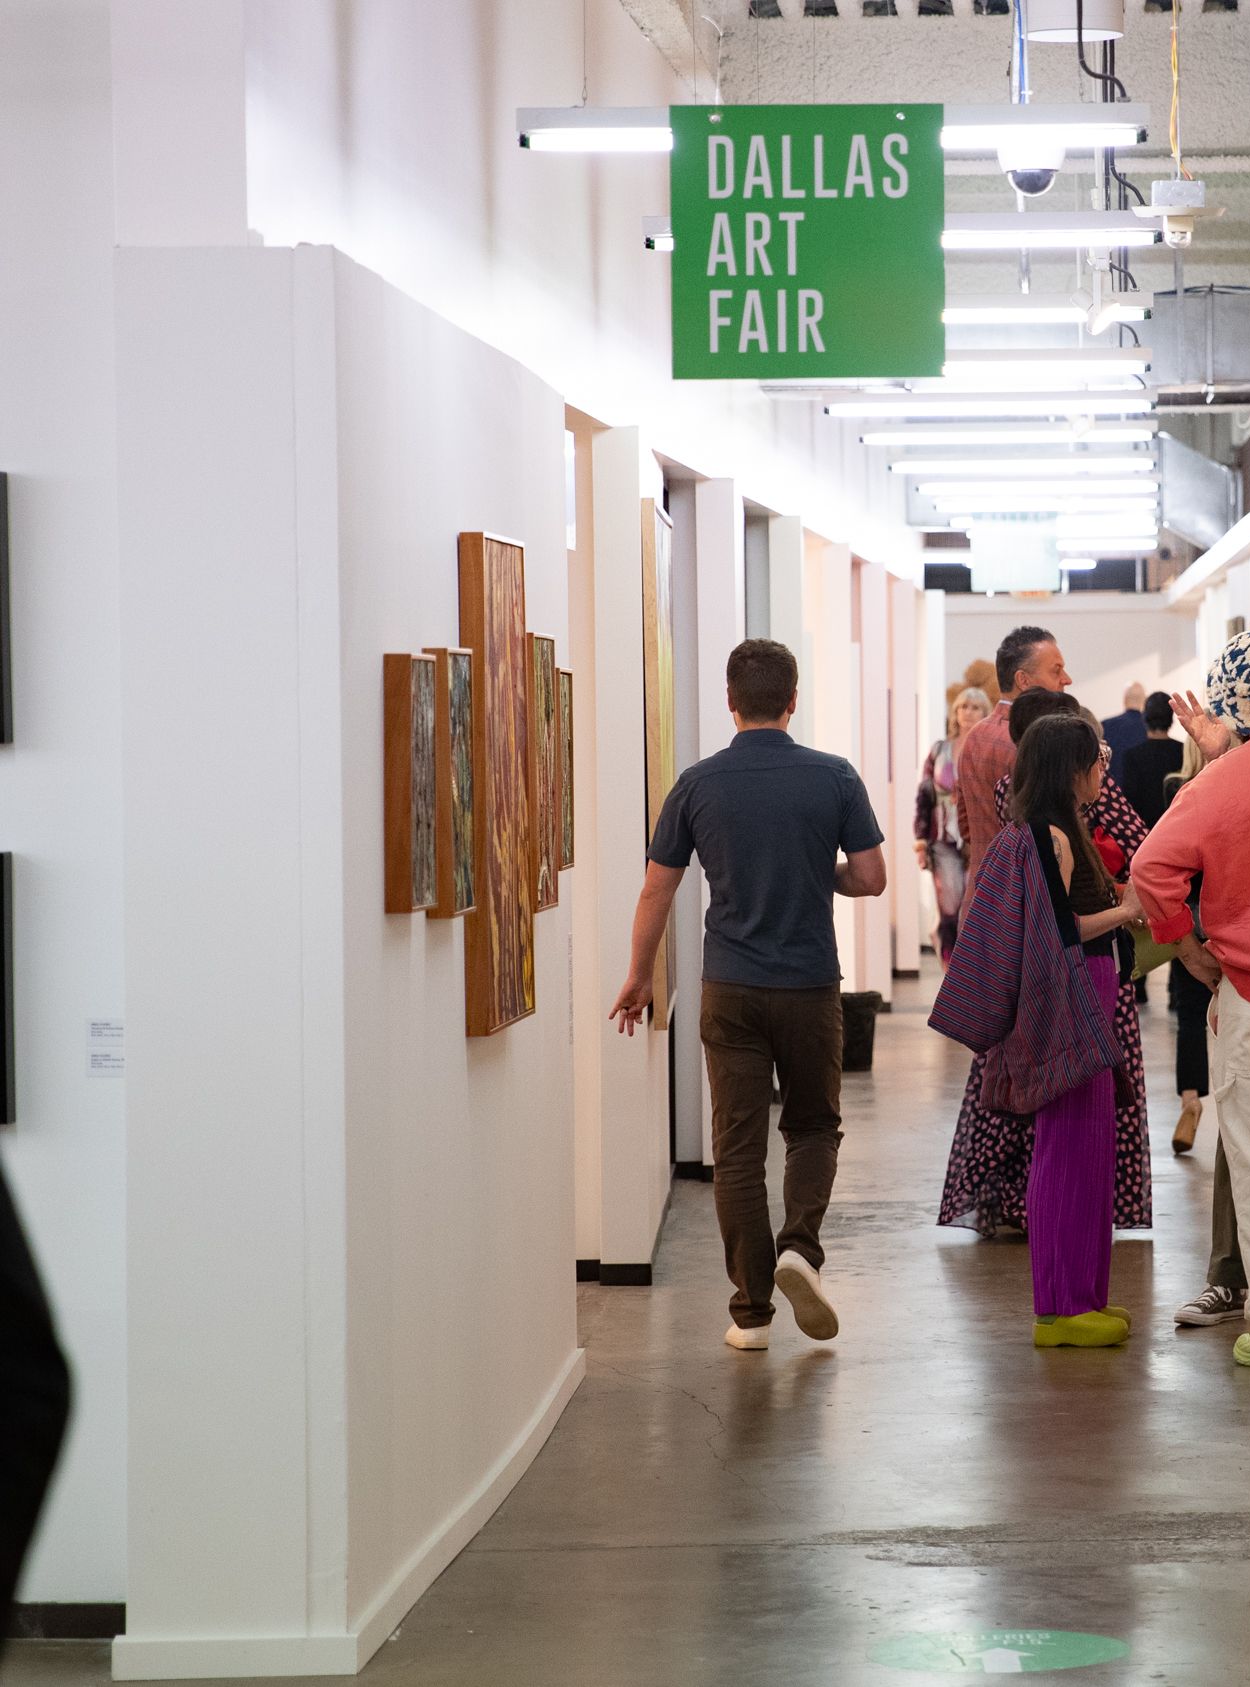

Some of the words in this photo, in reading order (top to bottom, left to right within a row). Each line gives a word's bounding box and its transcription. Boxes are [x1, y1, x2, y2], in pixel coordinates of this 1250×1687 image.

[708, 133, 909, 199] DALLAS
[706, 212, 805, 276] ART
[708, 289, 826, 353] FAIR
